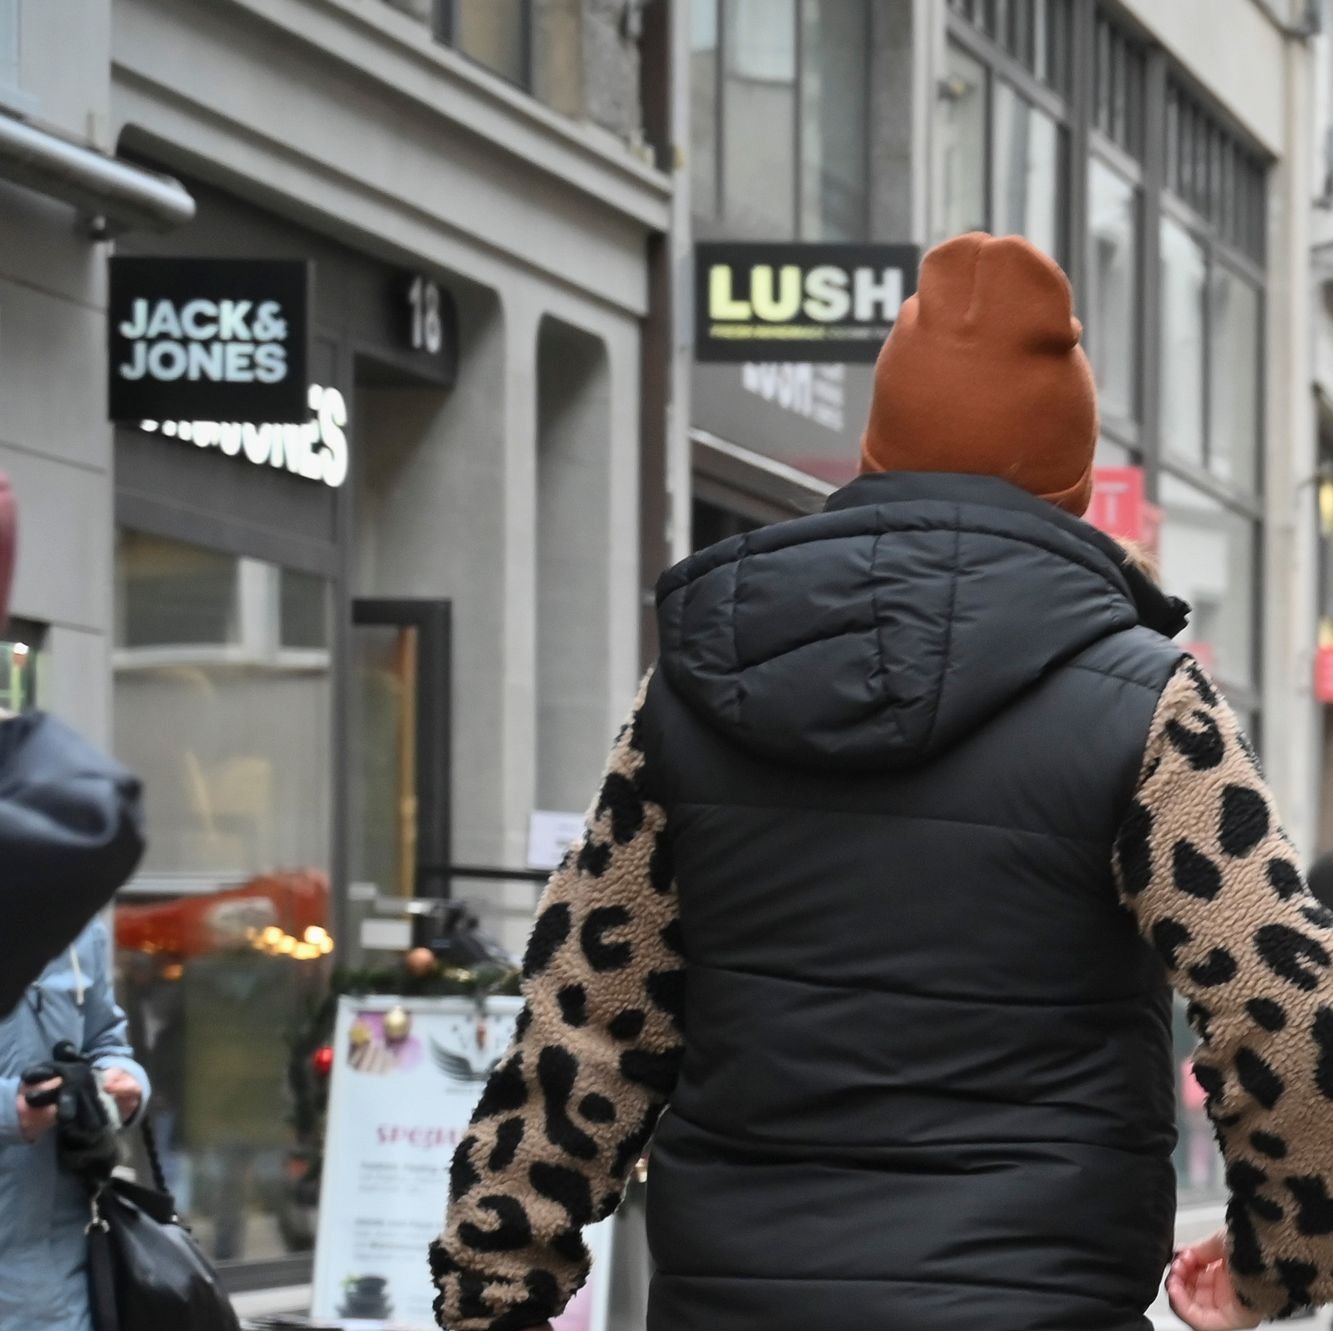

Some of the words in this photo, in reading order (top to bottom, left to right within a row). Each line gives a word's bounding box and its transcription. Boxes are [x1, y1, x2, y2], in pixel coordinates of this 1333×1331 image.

[408, 276, 442, 354] 18
[709, 264, 904, 322] LUSH
[119, 298, 288, 341] JACK&
[119, 340, 288, 383] JONES
